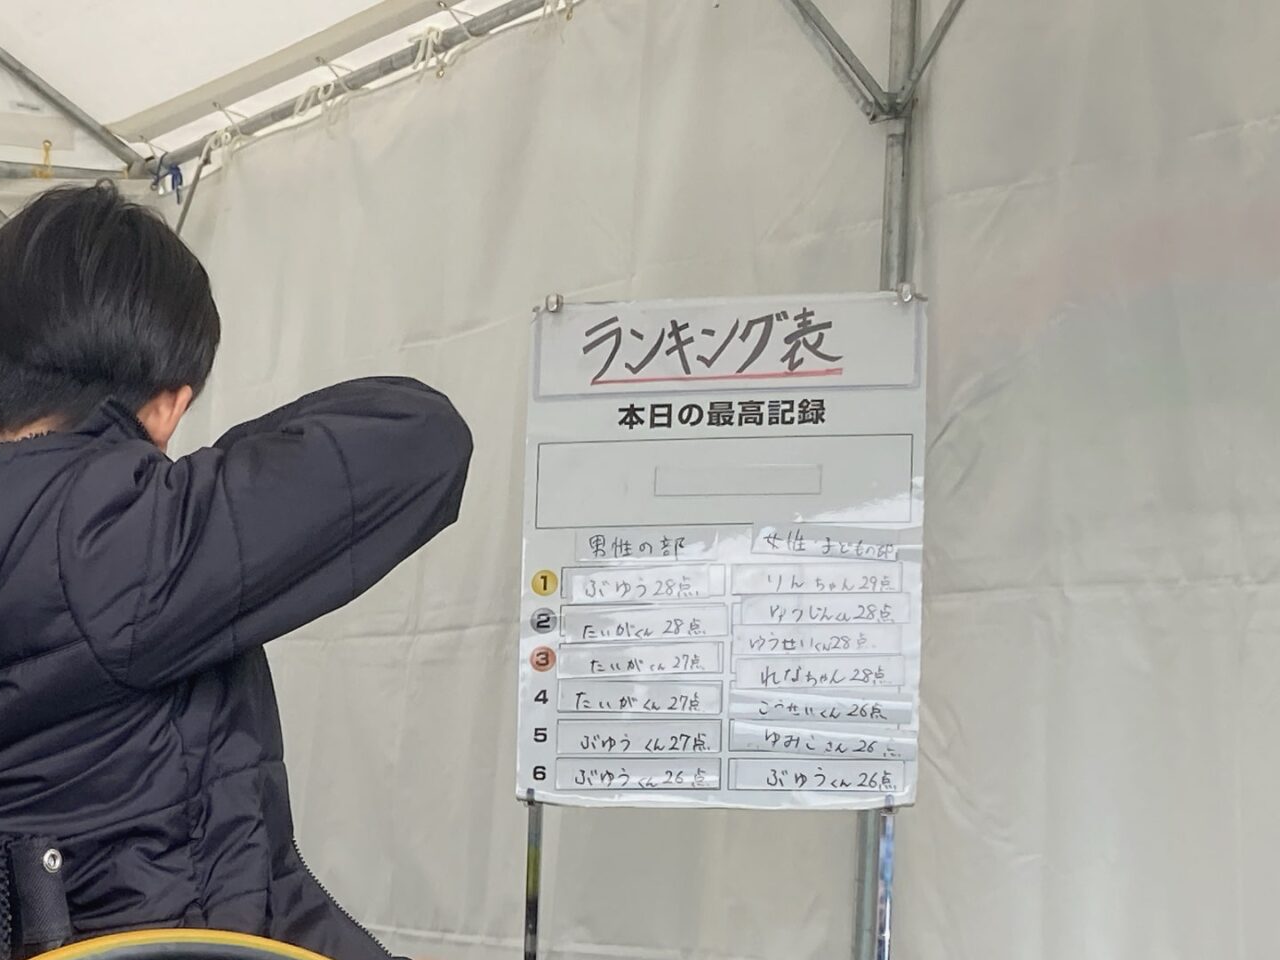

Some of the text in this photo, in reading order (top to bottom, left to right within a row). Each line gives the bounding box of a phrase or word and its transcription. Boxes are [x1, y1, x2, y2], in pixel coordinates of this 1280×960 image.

[582, 307, 844, 385] ランキング表
[617, 399, 826, 430] 本日の最高記録
[588, 534, 686, 561] 男性の部
[539, 574, 548, 591] 1
[536, 613, 551, 629] 2
[535, 651, 549, 667] 3
[534, 689, 549, 705] 4
[533, 728, 548, 743] 5
[532, 765, 547, 781] 6
